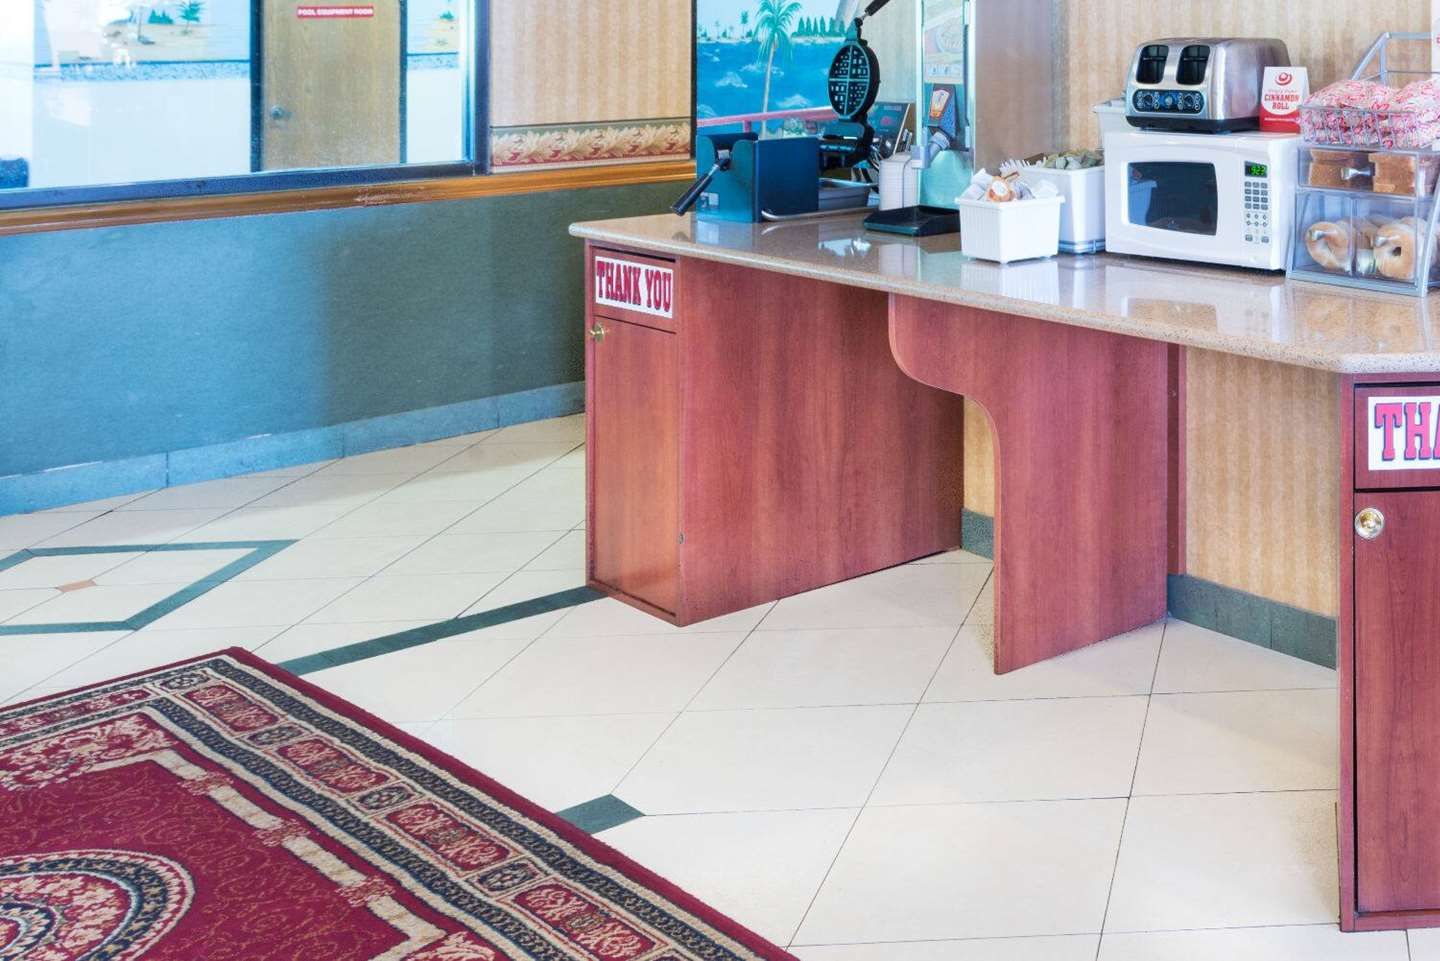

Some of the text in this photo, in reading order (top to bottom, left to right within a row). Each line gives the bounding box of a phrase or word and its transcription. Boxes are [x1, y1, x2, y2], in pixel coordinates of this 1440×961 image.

[1264, 94, 1299, 102] CINNAMON
[1272, 102, 1289, 110] ROLL
[596, 260, 672, 313] THANK YOU
